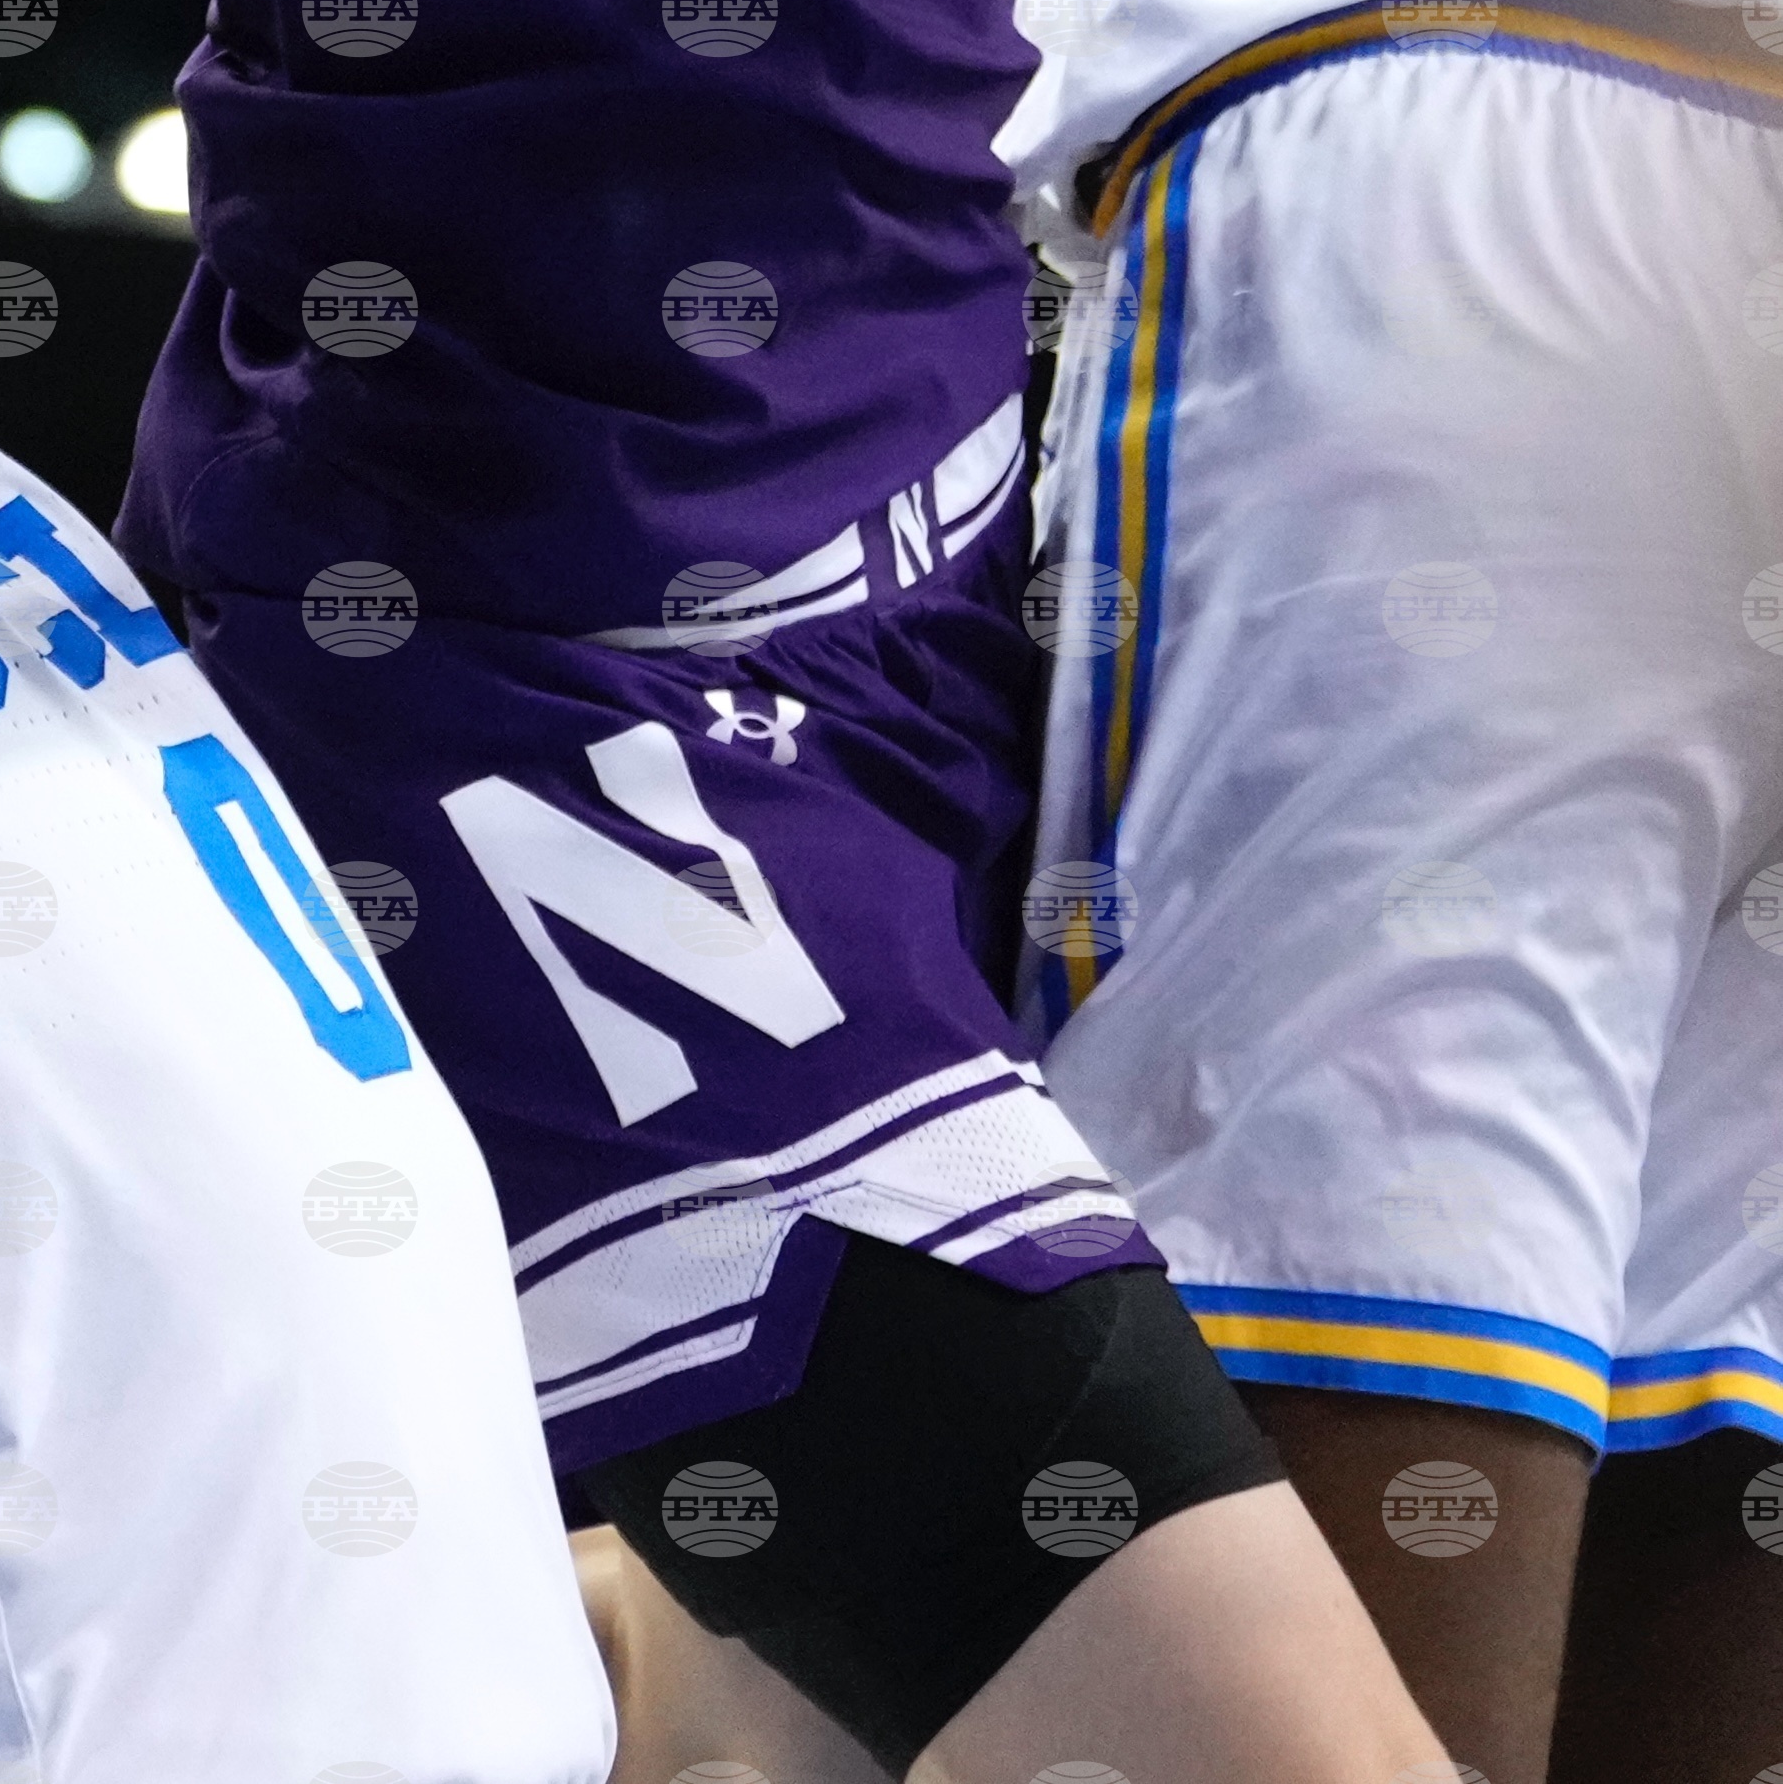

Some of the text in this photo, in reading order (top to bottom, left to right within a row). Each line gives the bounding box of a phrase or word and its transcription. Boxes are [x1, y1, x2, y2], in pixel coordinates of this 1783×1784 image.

[886, 479, 935, 589] N
[158, 732, 414, 1084] 0
[438, 719, 847, 1129] N
